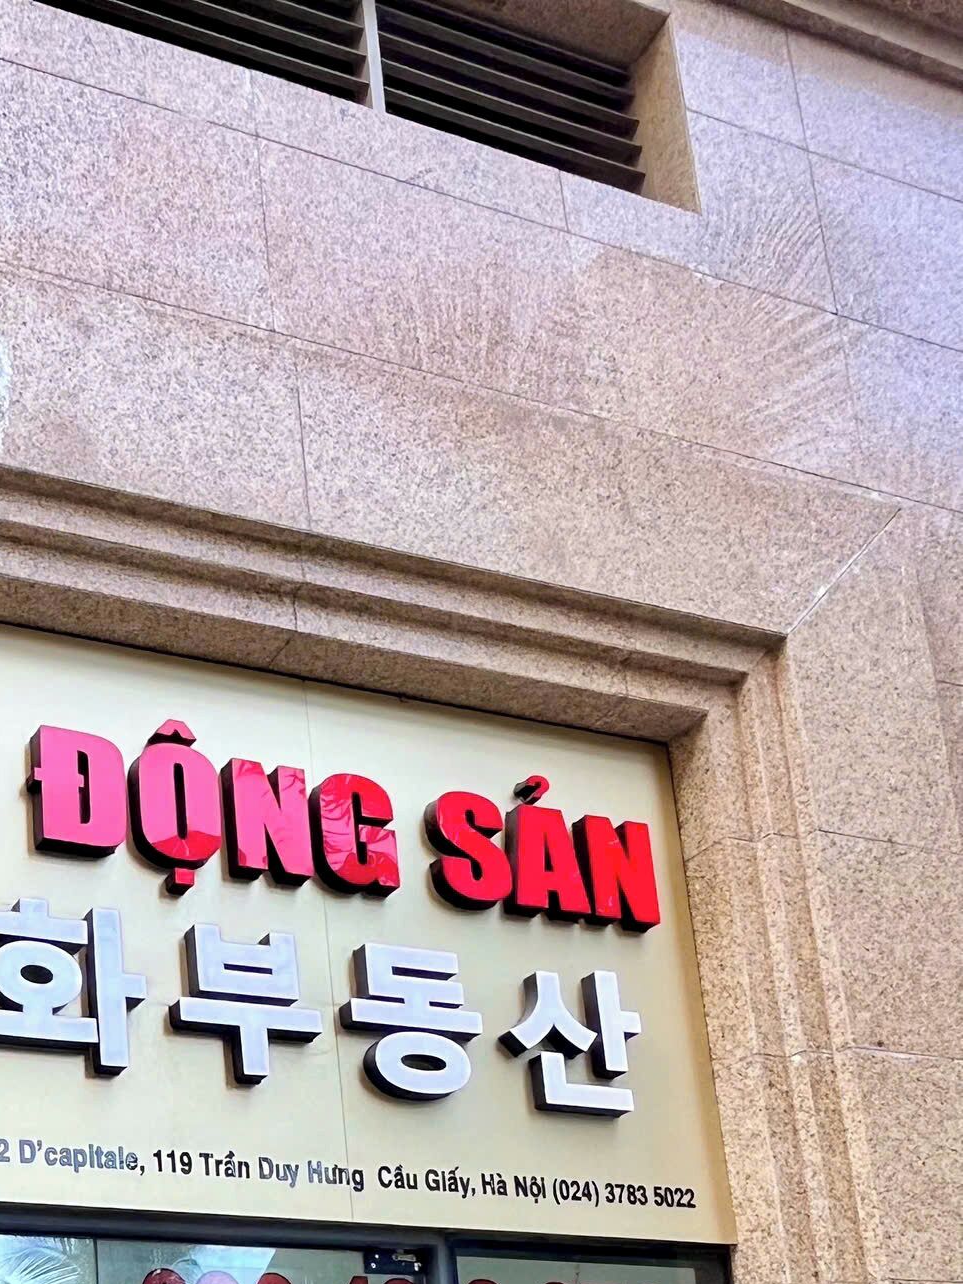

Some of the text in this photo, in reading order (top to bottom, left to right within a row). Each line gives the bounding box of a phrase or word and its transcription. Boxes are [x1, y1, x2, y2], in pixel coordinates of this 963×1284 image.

[25, 719, 401, 897] ĐỘNG
[425, 775, 661, 933] SẢN
[153, 1150, 192, 1176] 119
[199, 1150, 250, 1179] Trần
[258, 1157, 299, 1188] Duy
[308, 1160, 364, 1192] Hưng
[377, 1164, 418, 1190] Cầu
[425, 1167, 476, 1199] Giấy,
[481, 1172, 508, 1197] Hà
[513, 1175, 547, 1204] Nội
[553, 1180, 599, 1207] (024)
[605, 1183, 648, 1207] 3783
[654, 1186, 697, 1210] 5022
